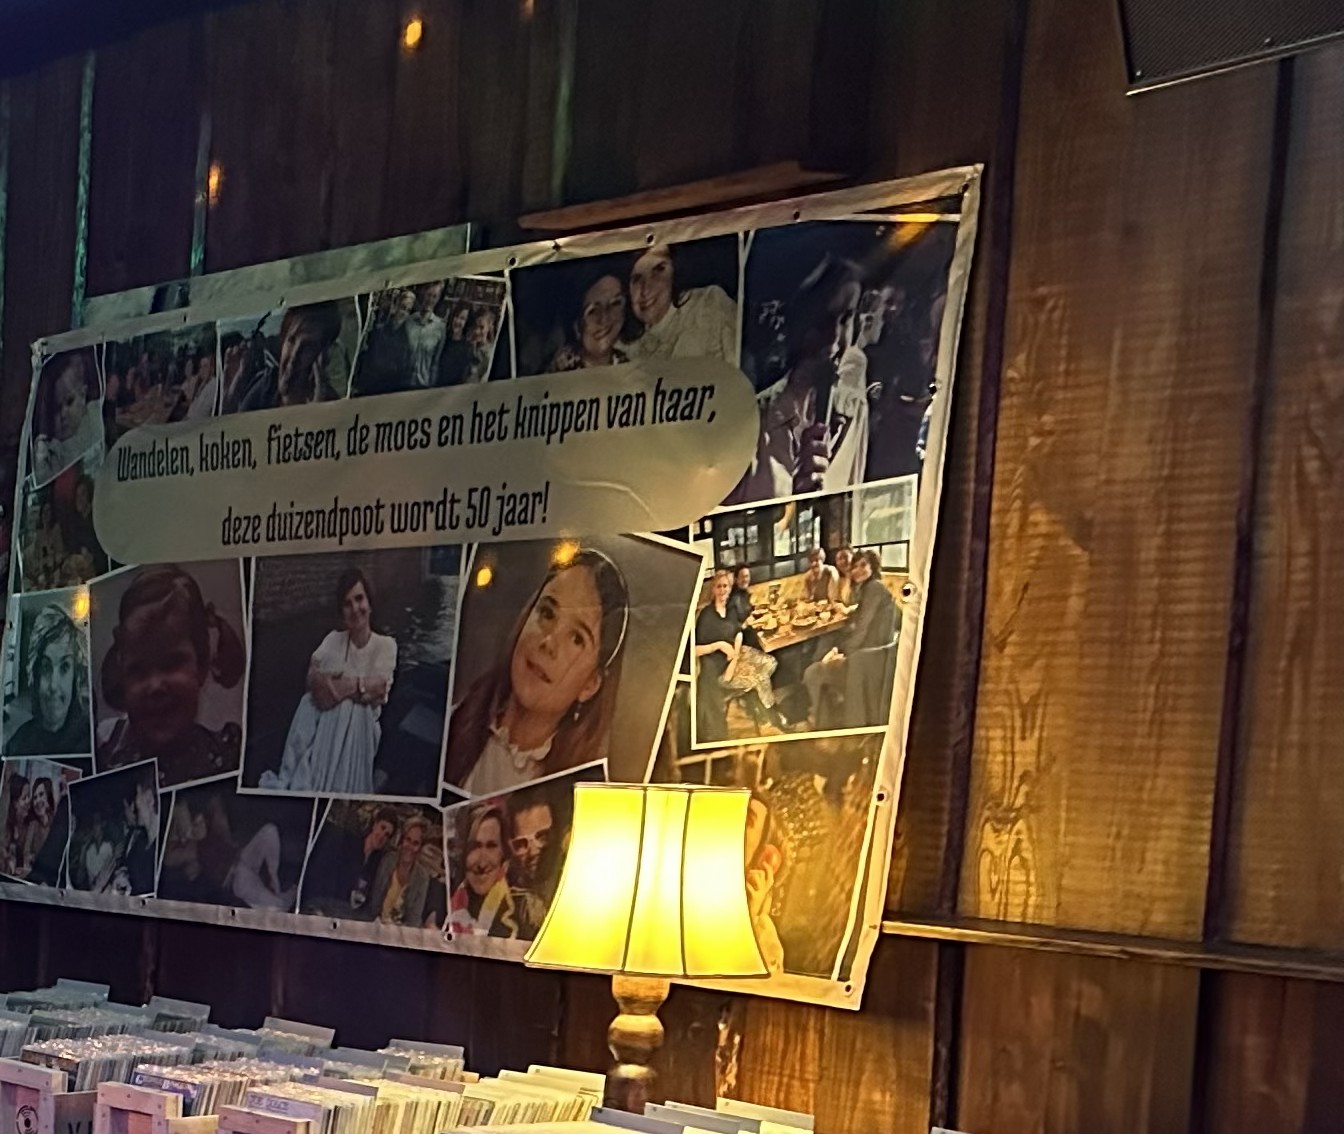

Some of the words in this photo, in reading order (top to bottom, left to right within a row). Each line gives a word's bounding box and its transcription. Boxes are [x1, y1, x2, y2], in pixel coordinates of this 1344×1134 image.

[117, 437, 195, 482] Wandelen,
[199, 431, 257, 473] koken,
[266, 423, 341, 465] fietsen,
[347, 413, 369, 457] de
[375, 415, 432, 455] moes
[438, 410, 463, 448] en
[469, 400, 511, 445] het
[513, 391, 601, 445] knippen
[606, 391, 647, 429] van
[651, 377, 717, 425] haar,
[222, 506, 262, 546] deze
[265, 496, 385, 546] duizendpoot
[390, 486, 461, 535] wordt
[465, 486, 491, 530] 50
[492, 481, 550, 537] jaar!
